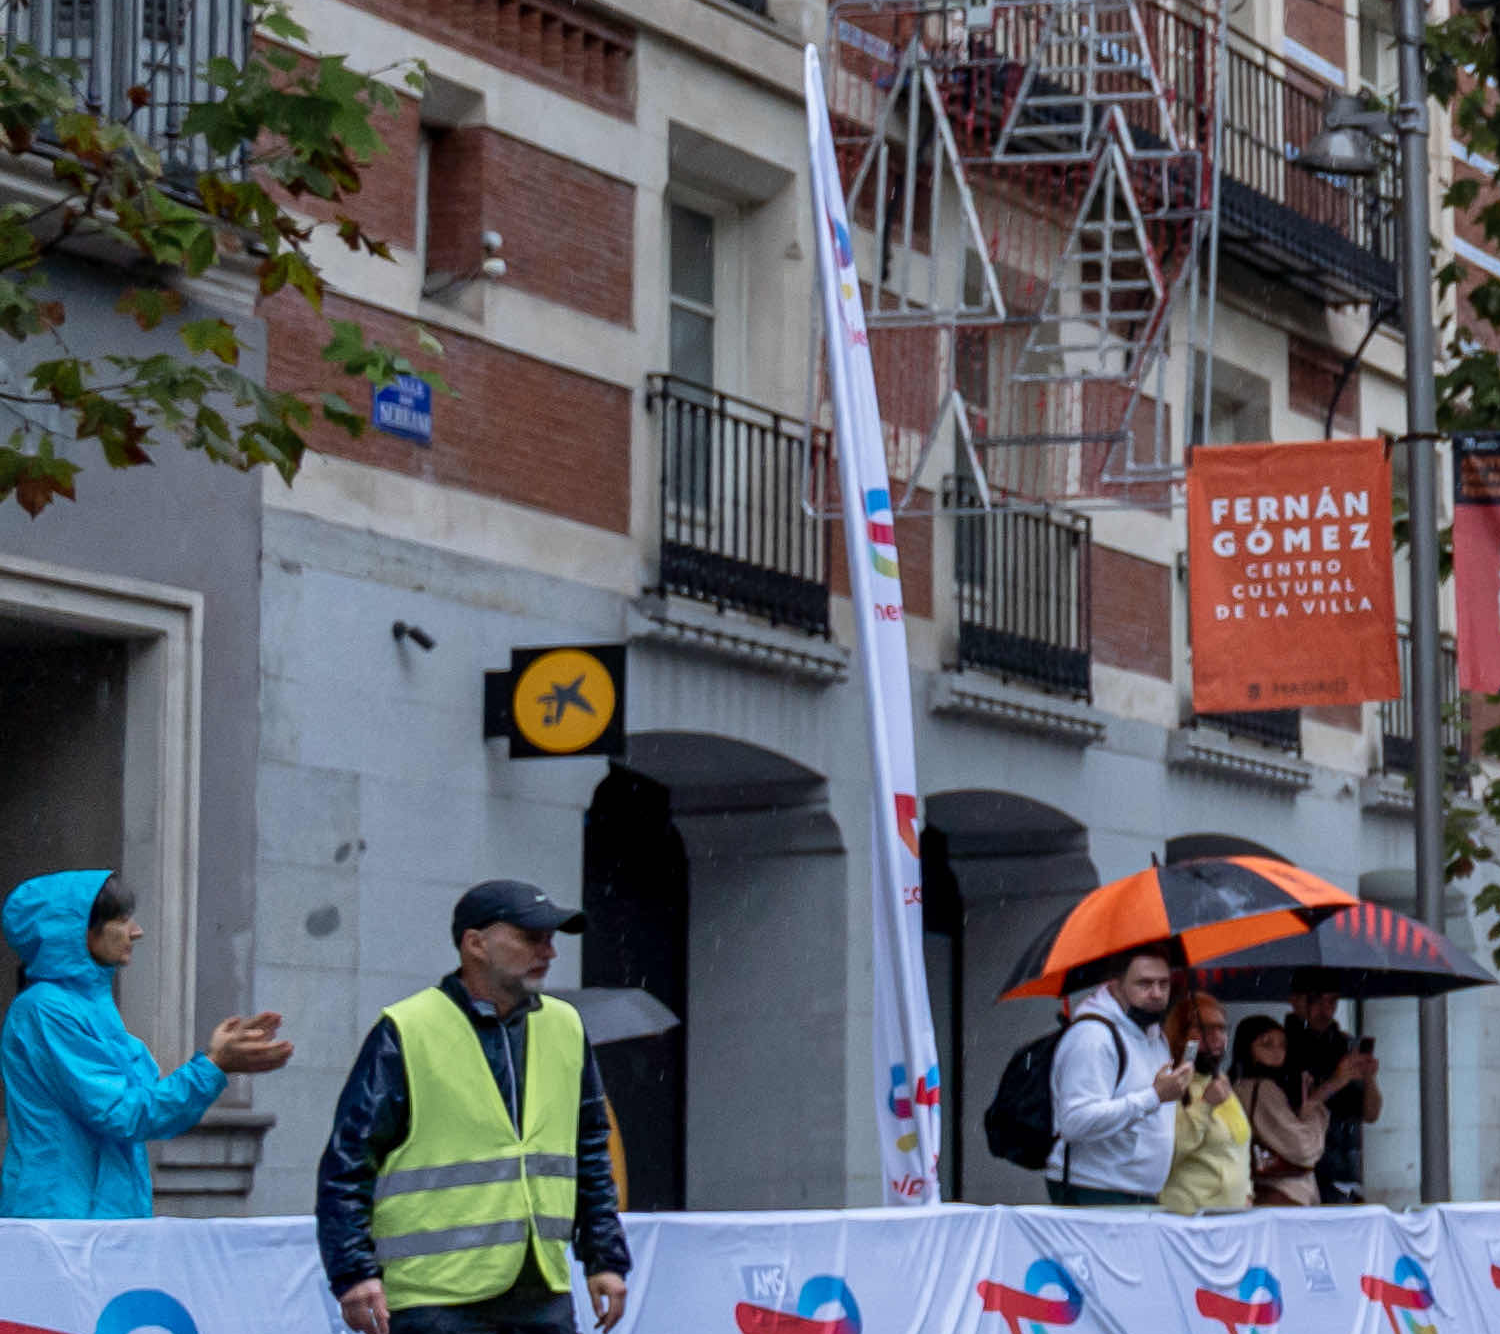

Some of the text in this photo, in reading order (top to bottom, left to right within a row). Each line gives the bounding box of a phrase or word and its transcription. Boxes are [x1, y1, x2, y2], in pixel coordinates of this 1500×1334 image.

[1211, 486, 1369, 525] FERNÁN
[1212, 522, 1371, 557] GÓMEZ
[1246, 558, 1341, 579] CENTRO
[1232, 577, 1355, 599] CULTURAL
[1215, 596, 1372, 620] DE LA VILLA
